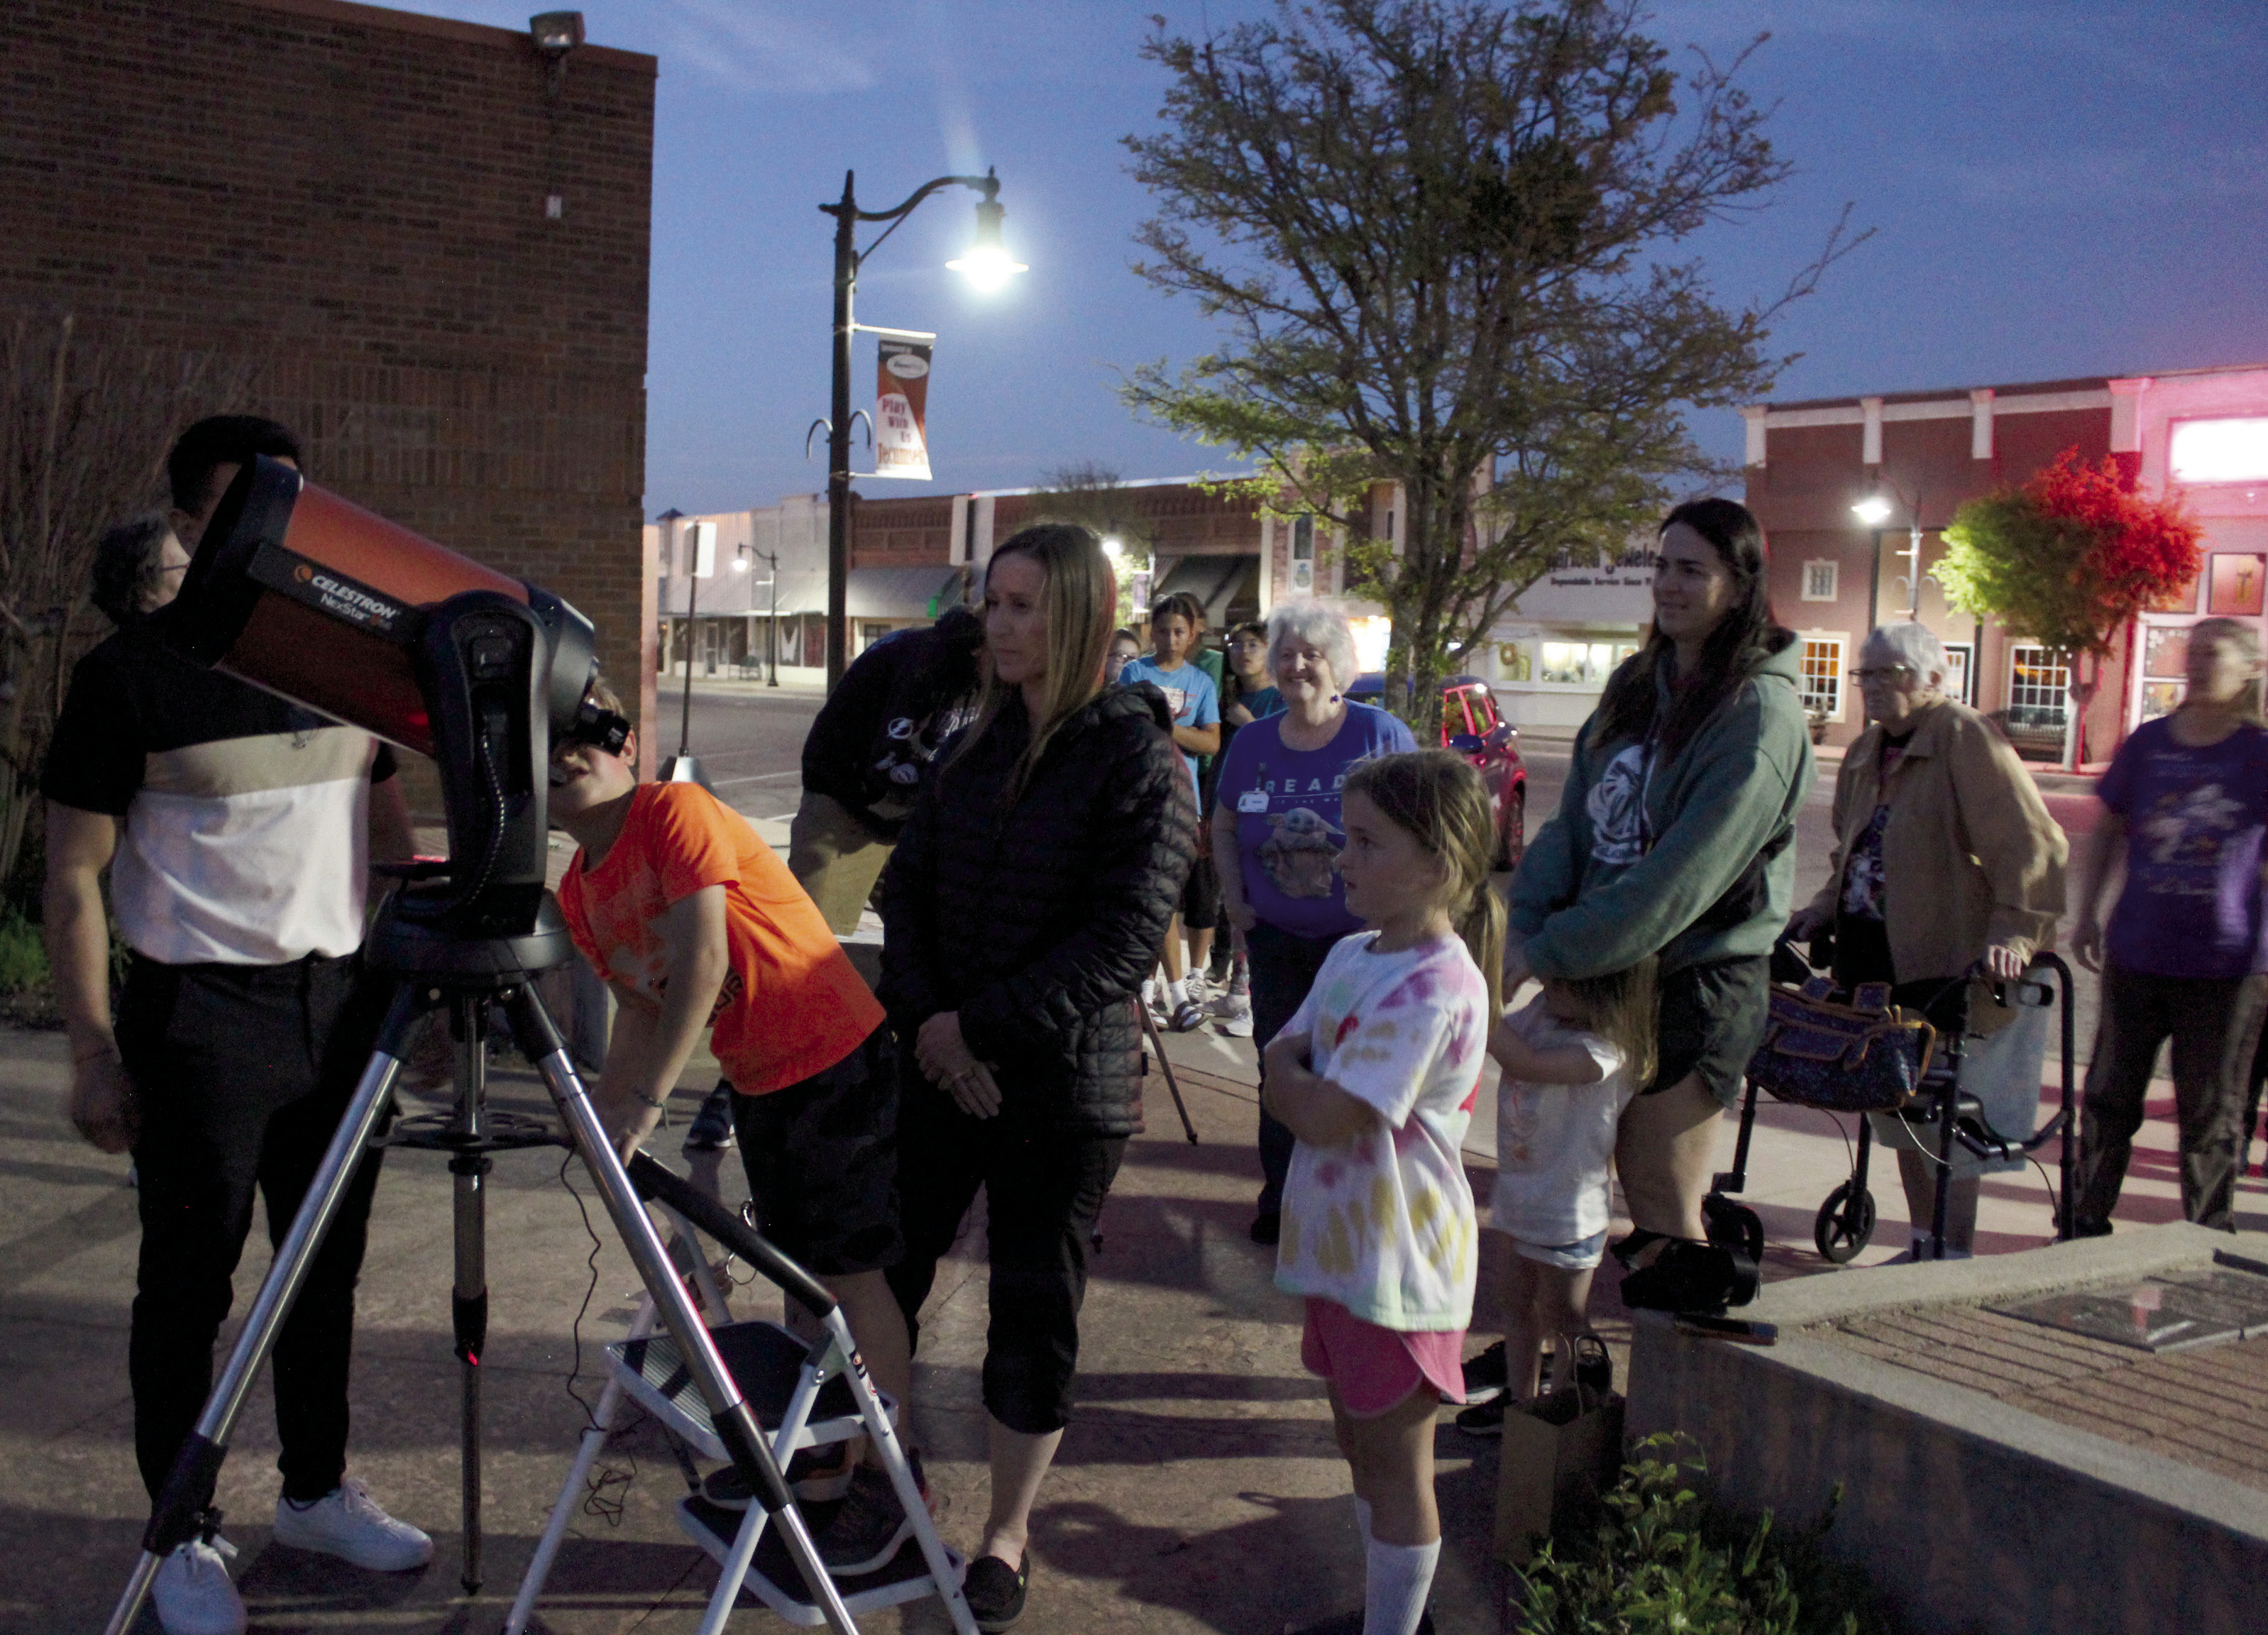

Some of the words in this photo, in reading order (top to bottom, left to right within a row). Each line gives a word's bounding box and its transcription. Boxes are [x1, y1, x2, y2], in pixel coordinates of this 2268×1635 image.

[312, 575, 397, 618] CELESTRON
[320, 593, 371, 621] NexStar
[1265, 774, 1346, 793] READ
